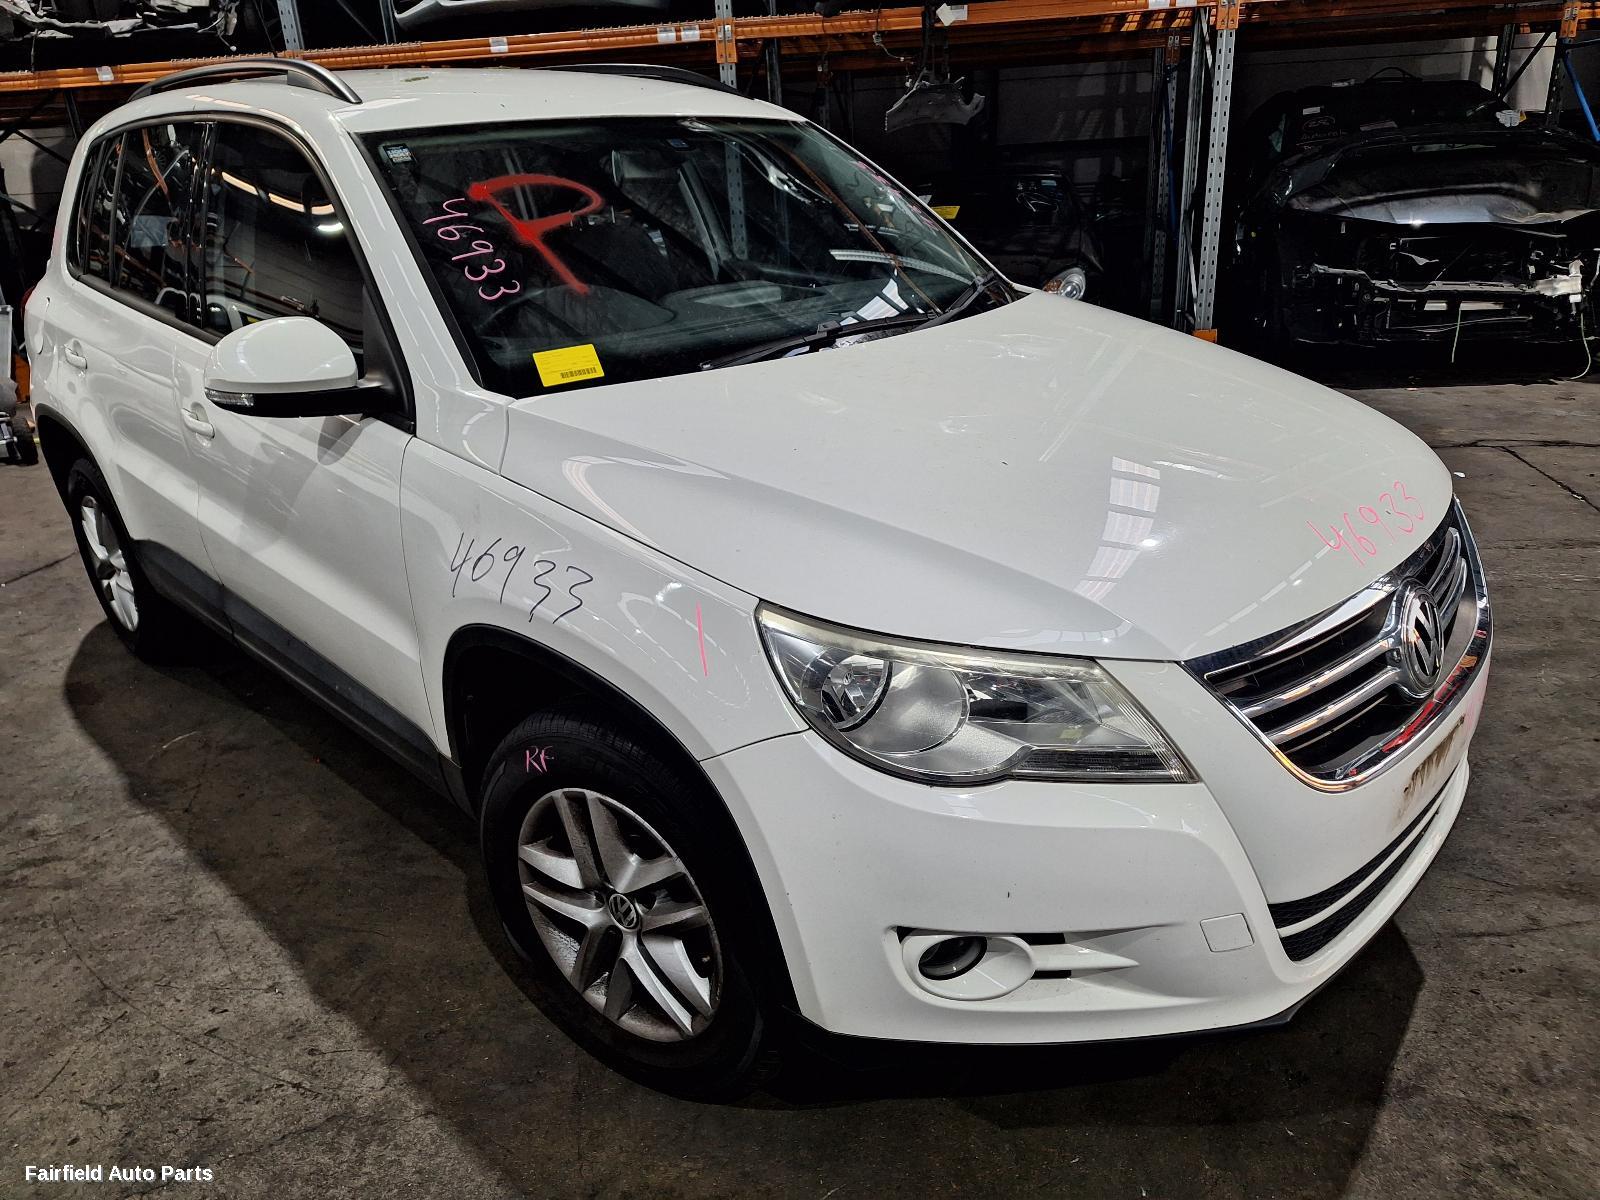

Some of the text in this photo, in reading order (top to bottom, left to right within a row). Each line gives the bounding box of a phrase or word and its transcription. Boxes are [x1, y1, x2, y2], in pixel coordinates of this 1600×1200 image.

[422, 197, 521, 301] 46933
[1306, 480, 1426, 568] 46933
[450, 531, 594, 624] 46933
[1404, 590, 1443, 685] VW
[525, 745, 555, 773] RF
